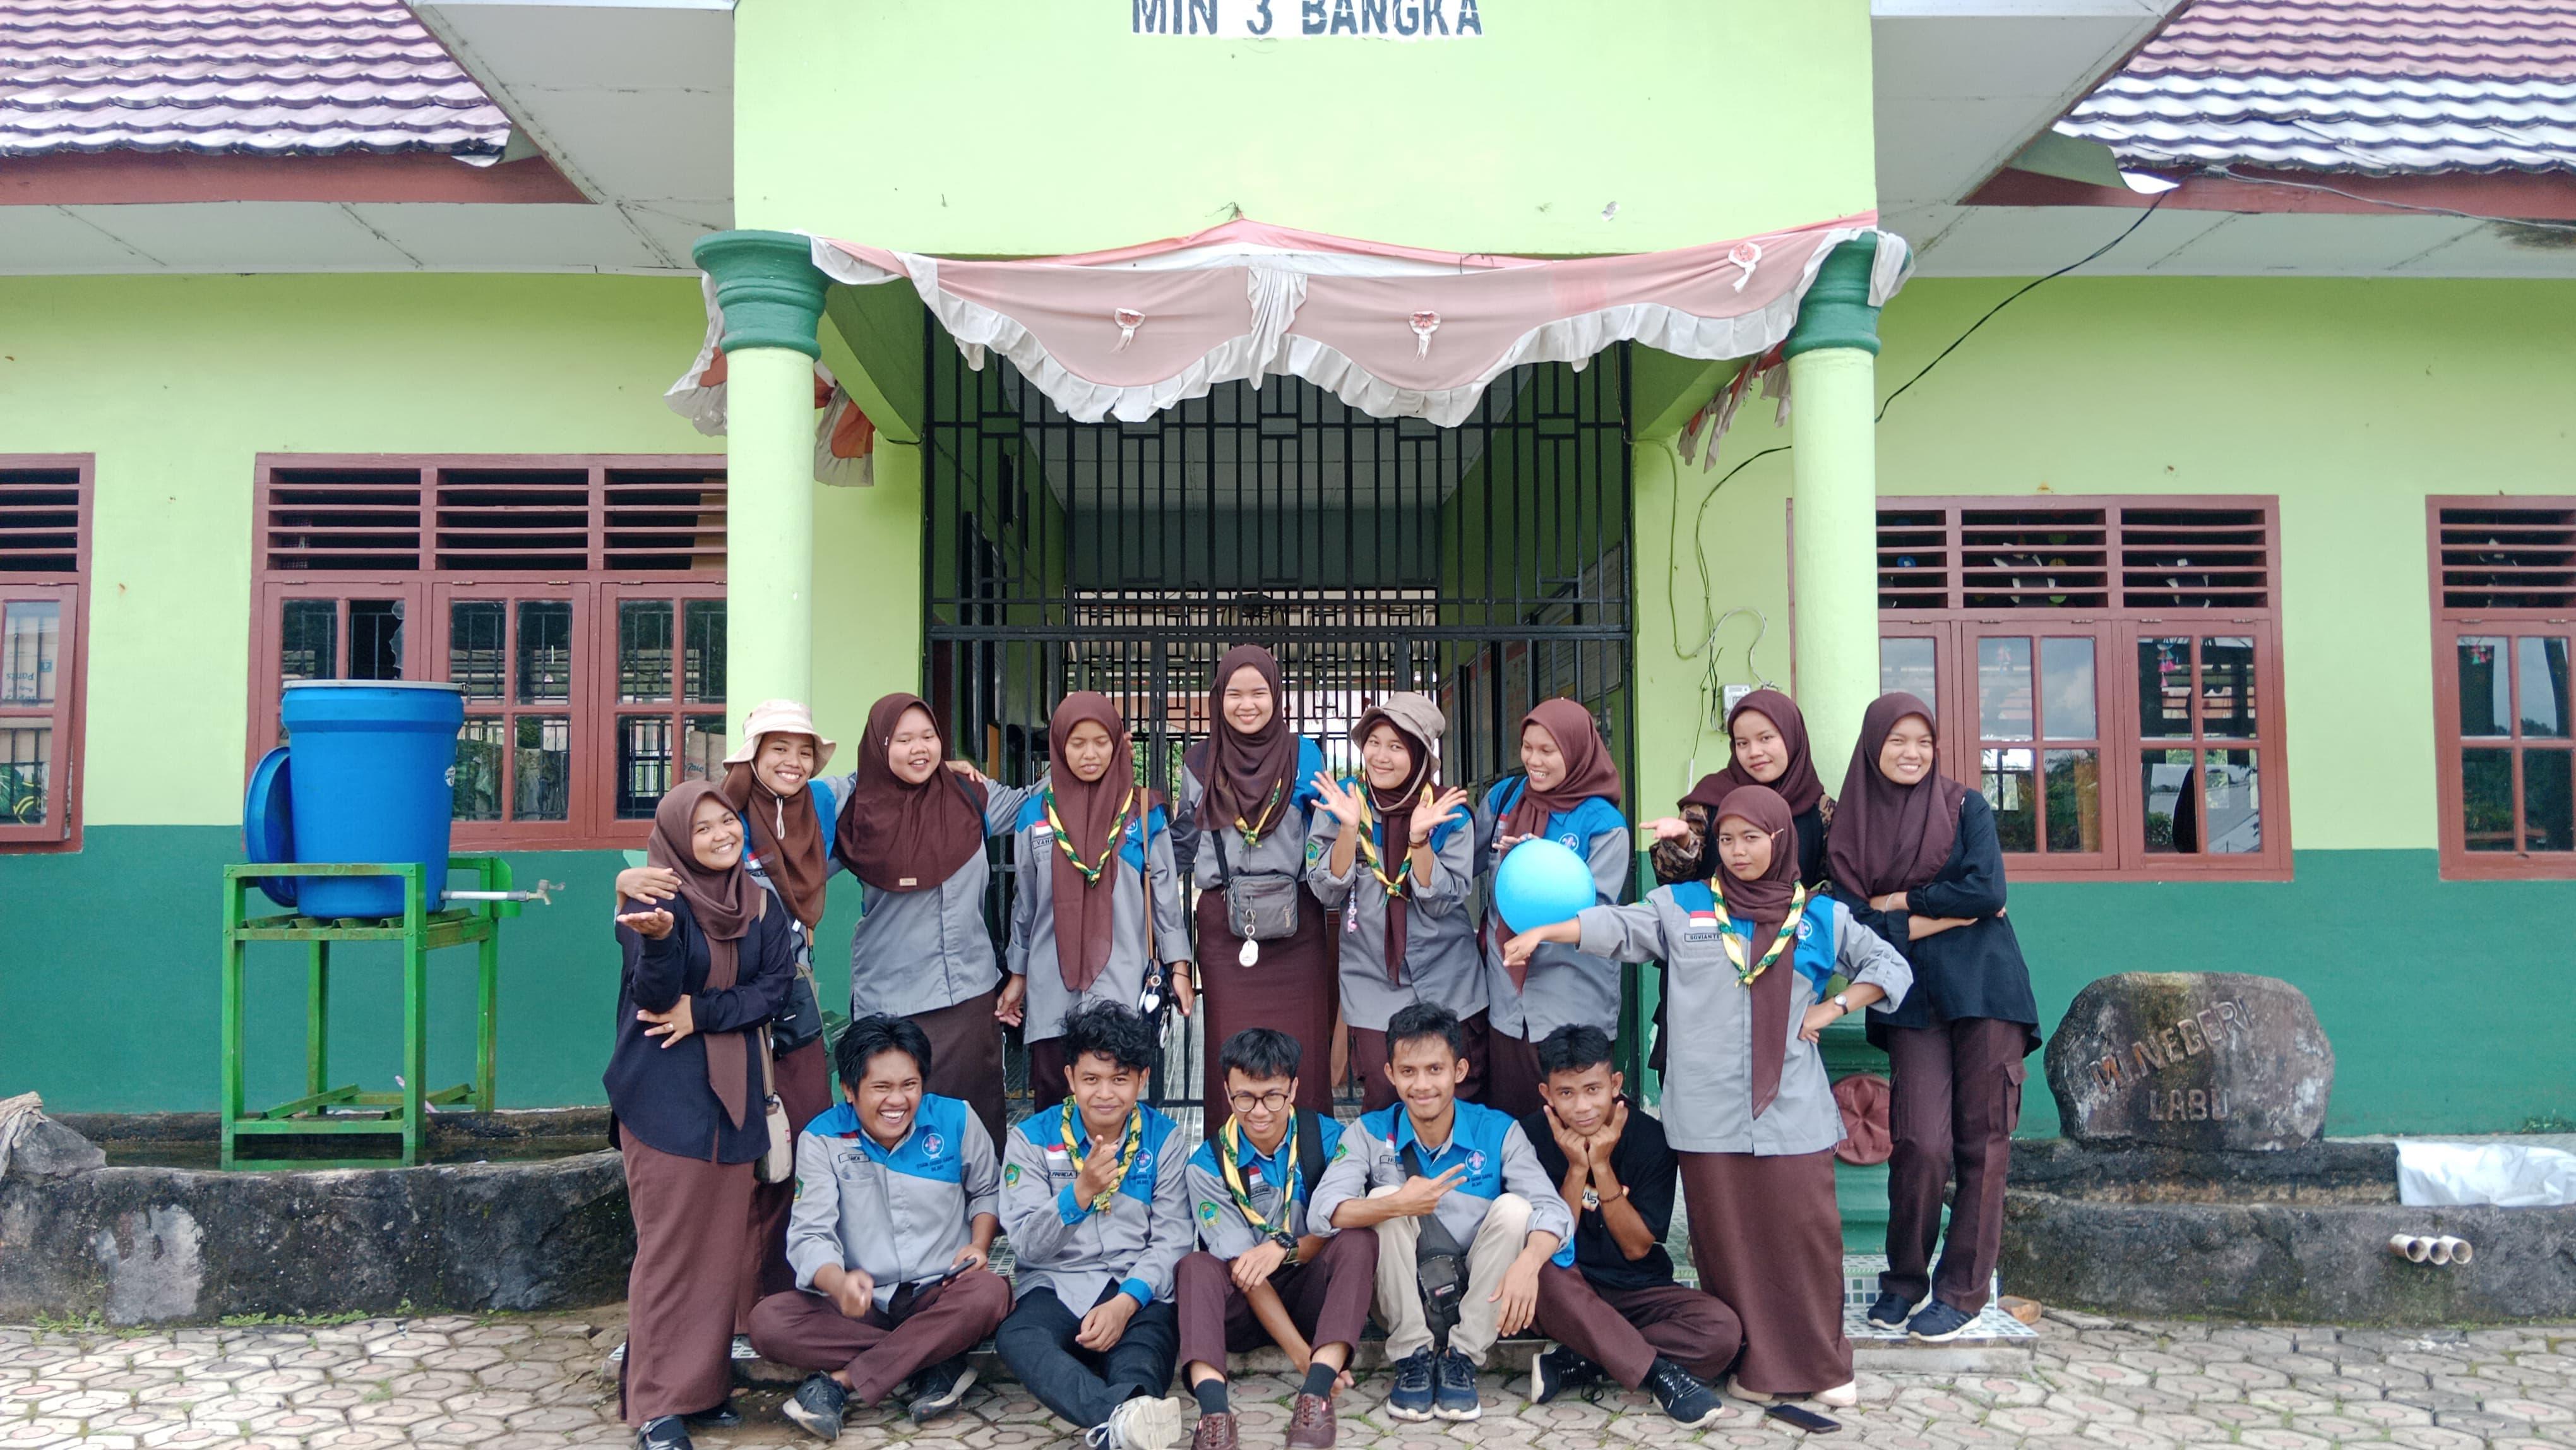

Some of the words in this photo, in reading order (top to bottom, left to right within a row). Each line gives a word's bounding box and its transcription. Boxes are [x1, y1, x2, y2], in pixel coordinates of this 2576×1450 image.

[1133, 0, 1217, 35] MIN
[1246, 0, 1273, 35] 3
[1302, 0, 1482, 35] BANGKA
[2131, 996, 2252, 1077] NEGERI
[2148, 1088, 2230, 1121] LABU
